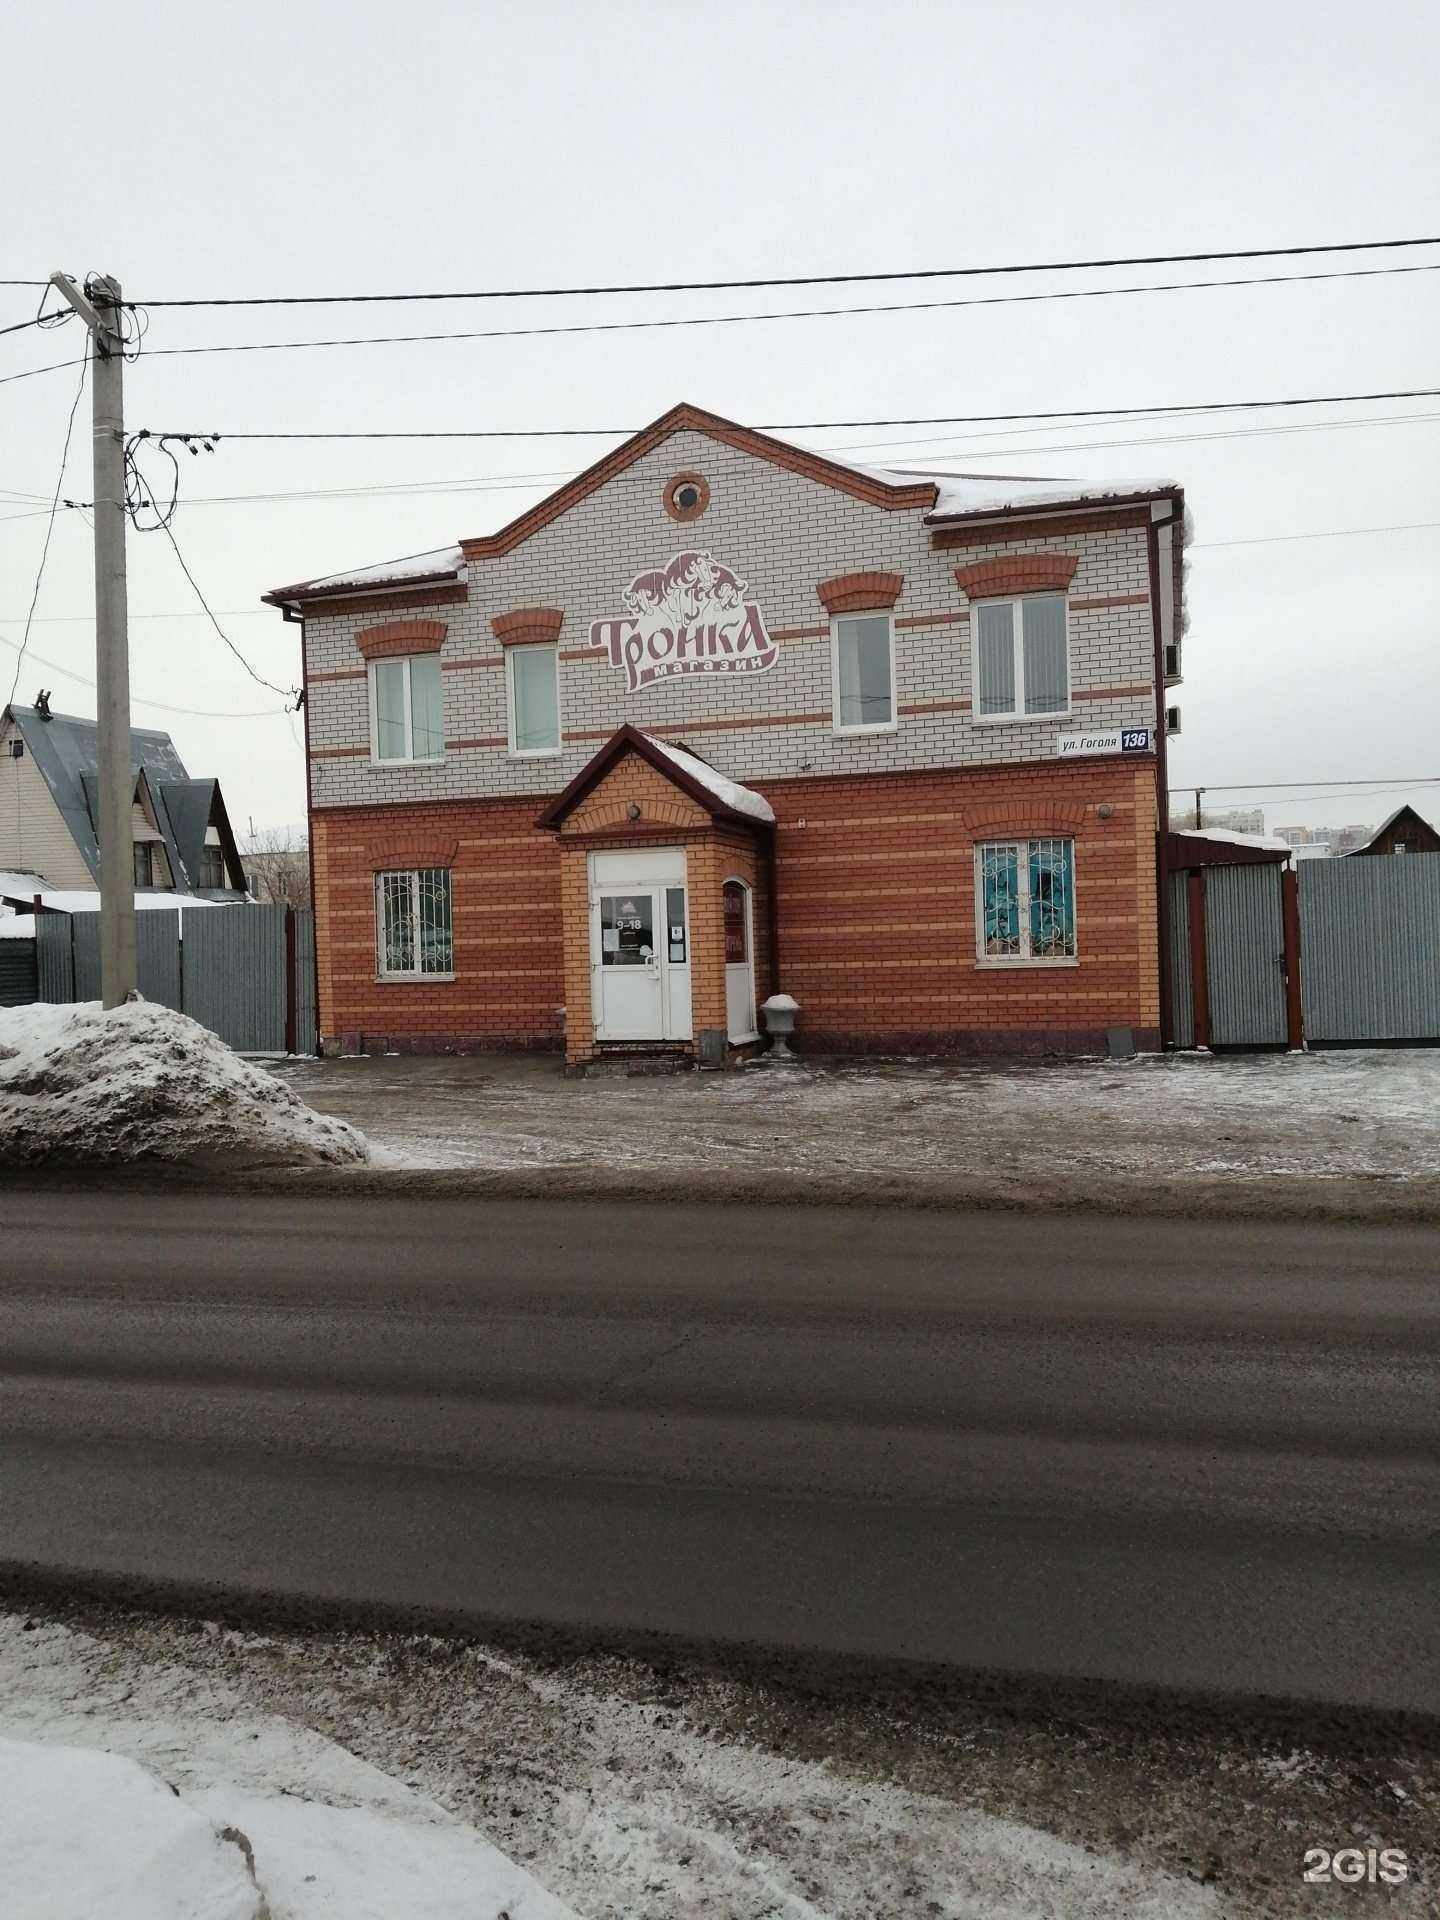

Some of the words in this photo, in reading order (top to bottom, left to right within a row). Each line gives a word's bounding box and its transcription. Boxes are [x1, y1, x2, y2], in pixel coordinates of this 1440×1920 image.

[653, 657, 763, 677] магазин
[1063, 741, 1078, 752] ул.
[1081, 738, 1117, 748] Гоголя
[1123, 733, 1147, 747] 136
